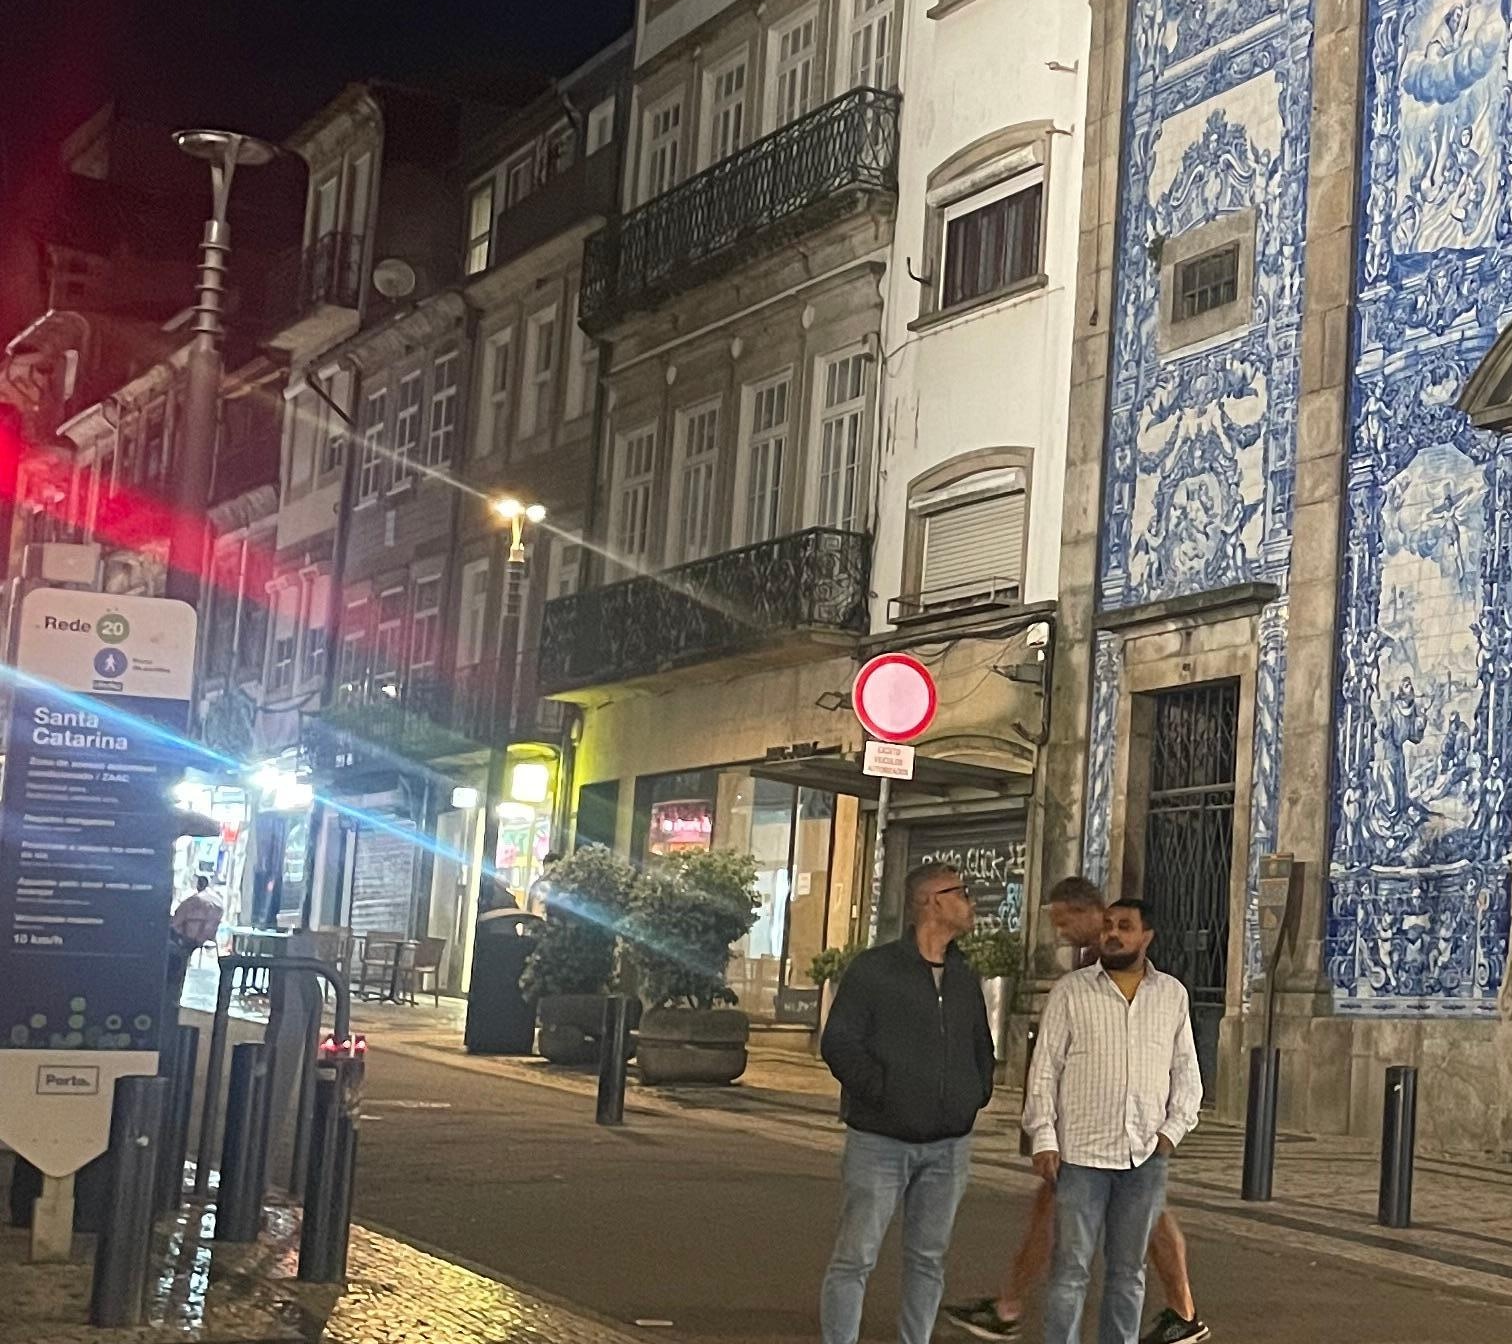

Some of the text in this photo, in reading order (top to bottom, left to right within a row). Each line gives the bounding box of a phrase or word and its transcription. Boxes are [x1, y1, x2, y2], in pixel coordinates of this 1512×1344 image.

[44, 615, 124, 636] Rede 20
[33, 706, 99, 728] Santa
[32, 726, 128, 750] Catarina
